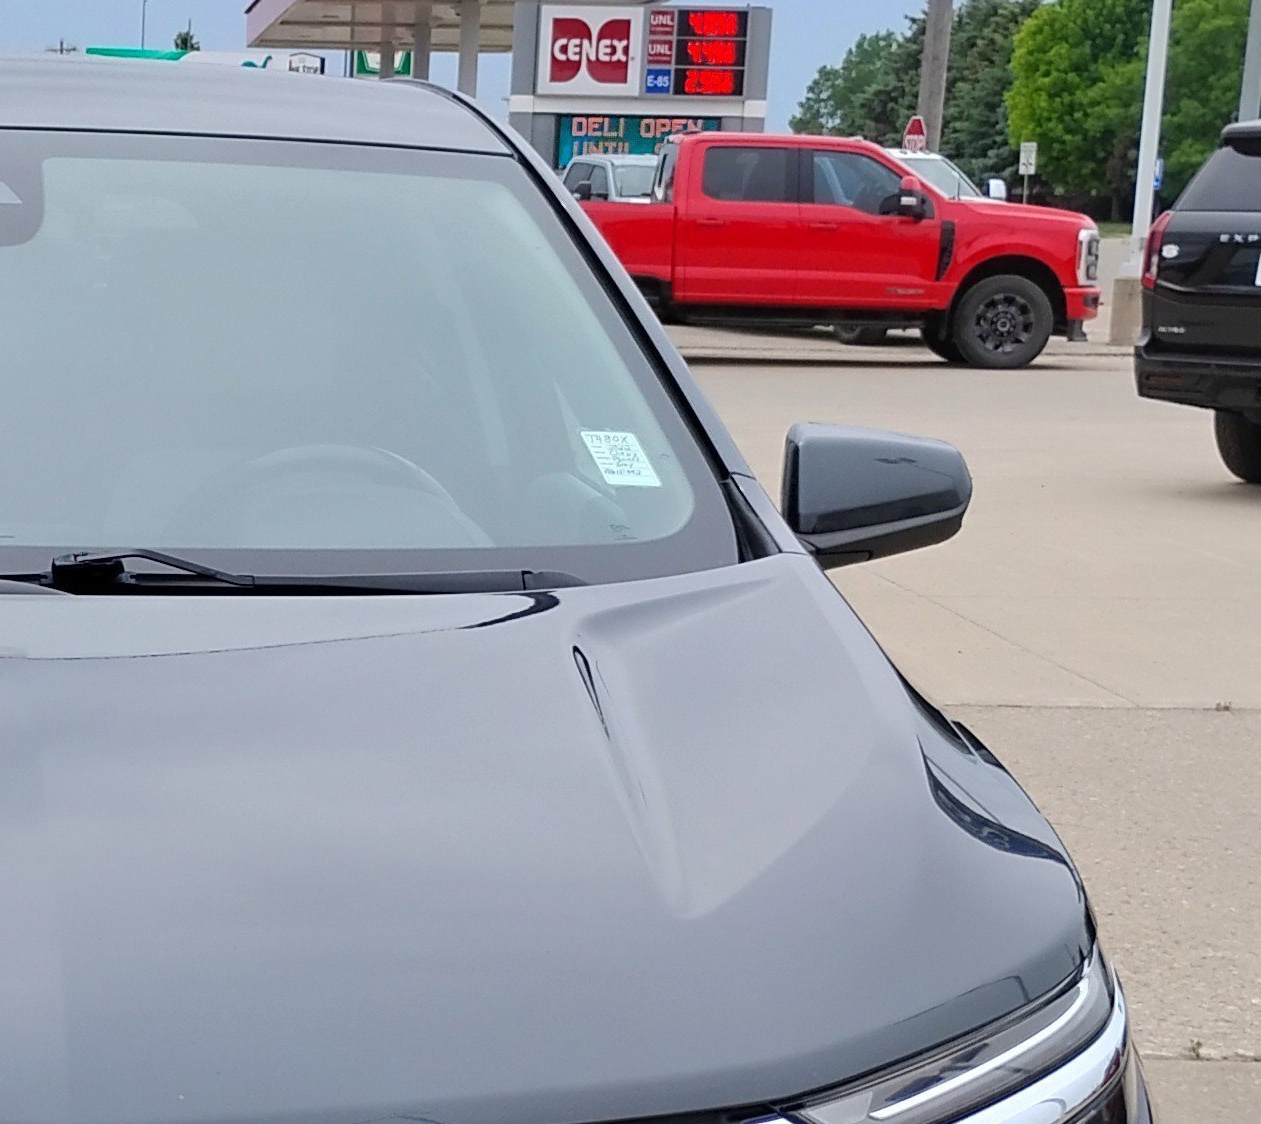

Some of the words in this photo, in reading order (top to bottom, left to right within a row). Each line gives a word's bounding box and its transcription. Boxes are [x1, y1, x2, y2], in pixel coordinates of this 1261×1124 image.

[651, 14, 674, 25] UNL
[553, 38, 627, 61] CENEX
[648, 44, 671, 54] UNL
[572, 117, 624, 137] DELI
